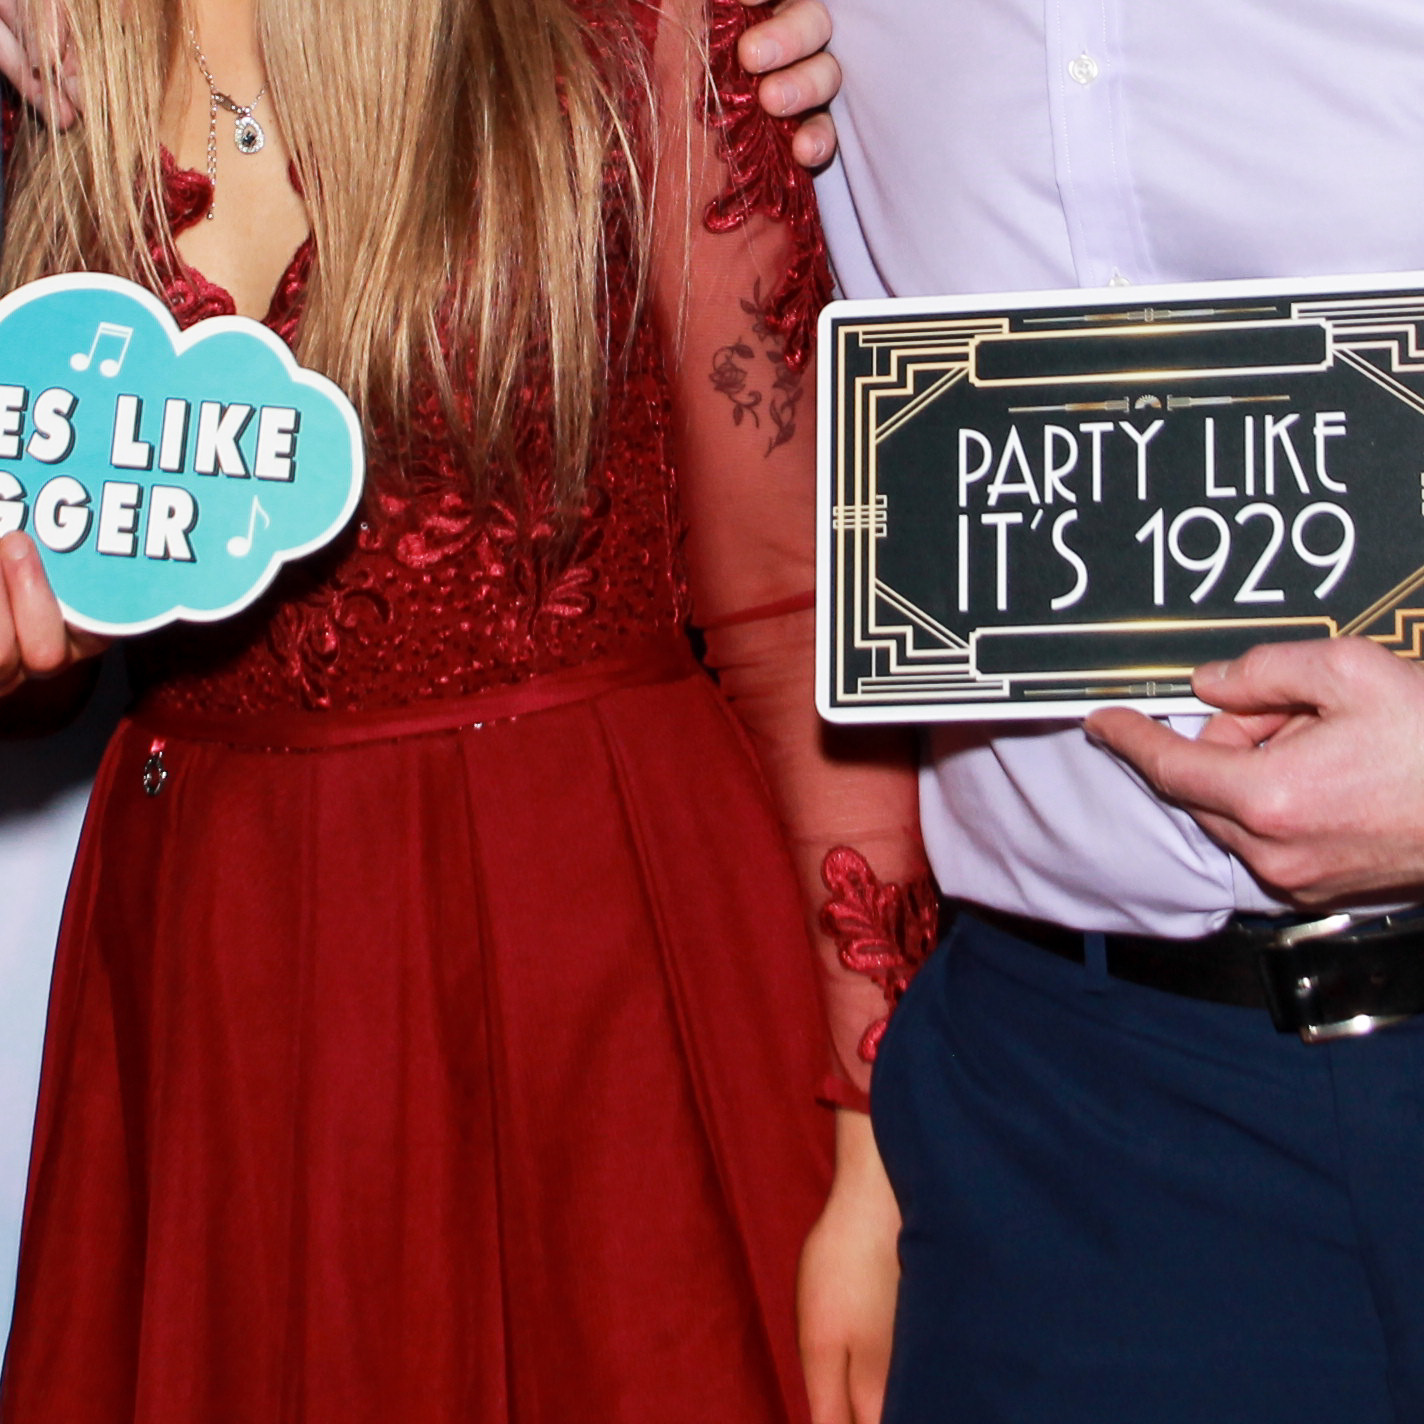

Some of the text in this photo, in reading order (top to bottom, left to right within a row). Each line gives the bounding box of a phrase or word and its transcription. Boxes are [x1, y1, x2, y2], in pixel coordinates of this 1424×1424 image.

[109, 393, 301, 482] LIKE
[957, 410, 1348, 508] PARTY LIKE
[957, 501, 1356, 612] IT'S 1929
